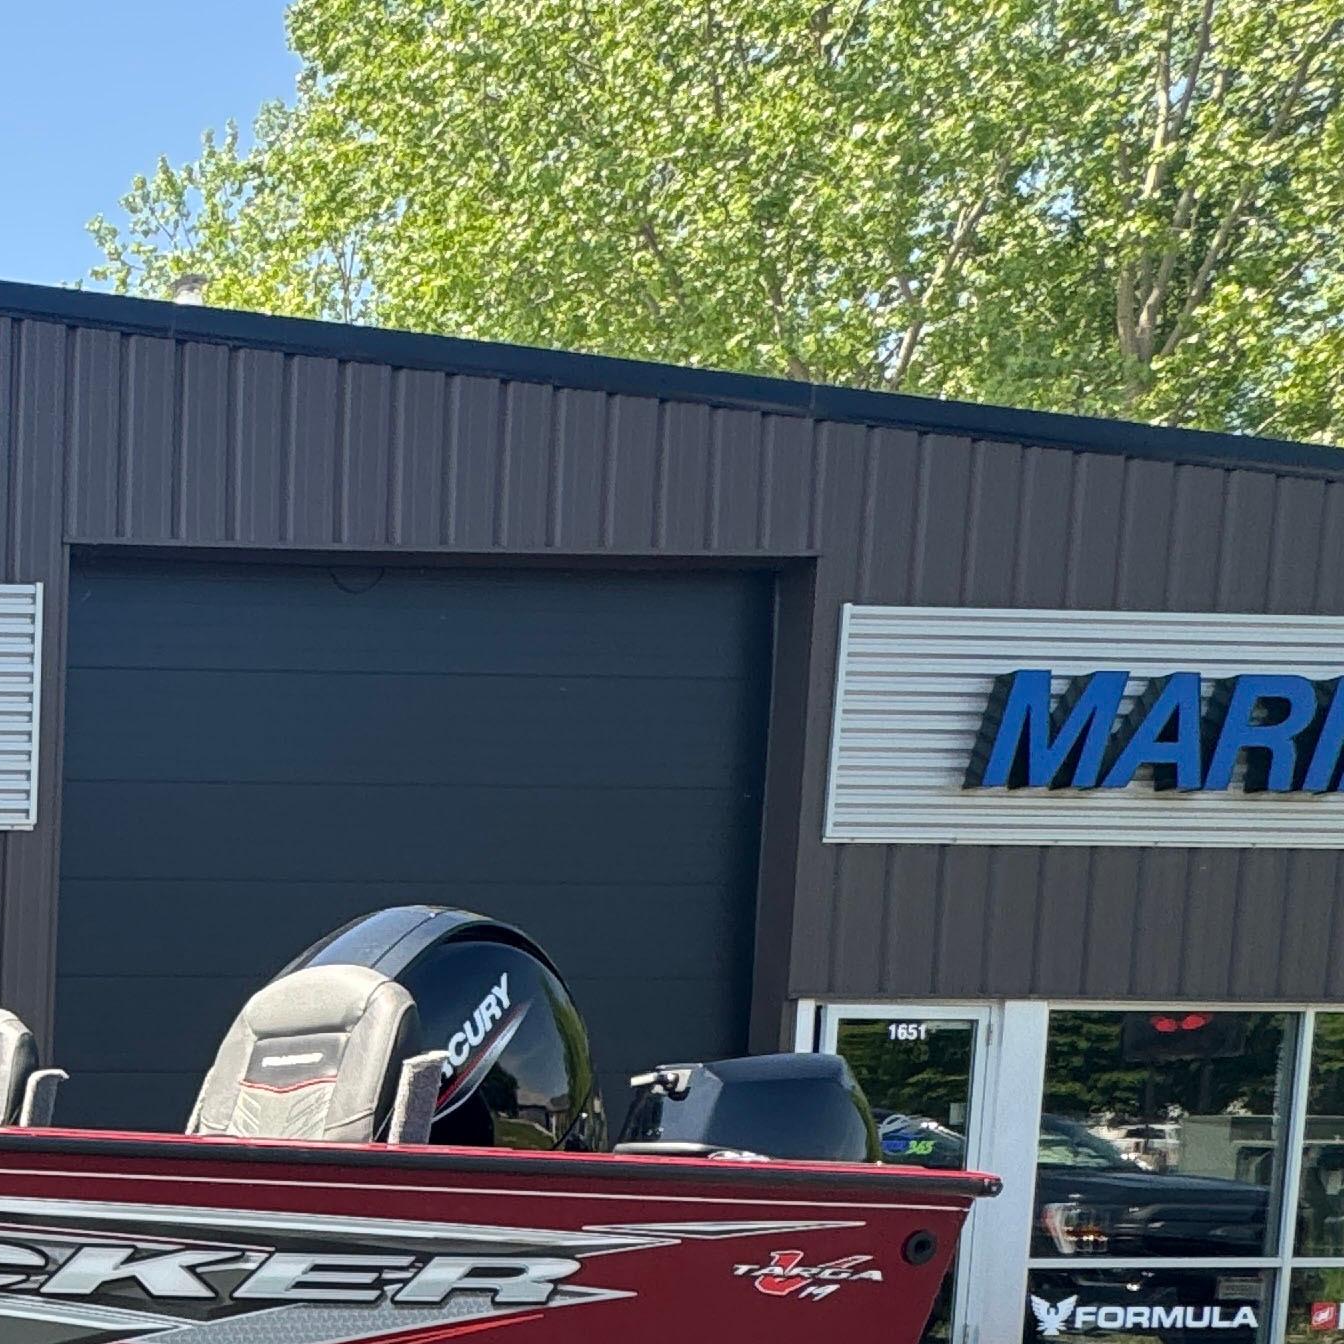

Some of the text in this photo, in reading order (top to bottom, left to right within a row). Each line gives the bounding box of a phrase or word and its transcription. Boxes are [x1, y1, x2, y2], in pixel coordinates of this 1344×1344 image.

[888, 1023, 928, 1040] 1651
[732, 1264, 884, 1282] TARGA
[1075, 1306, 1259, 1328] FORMULA
